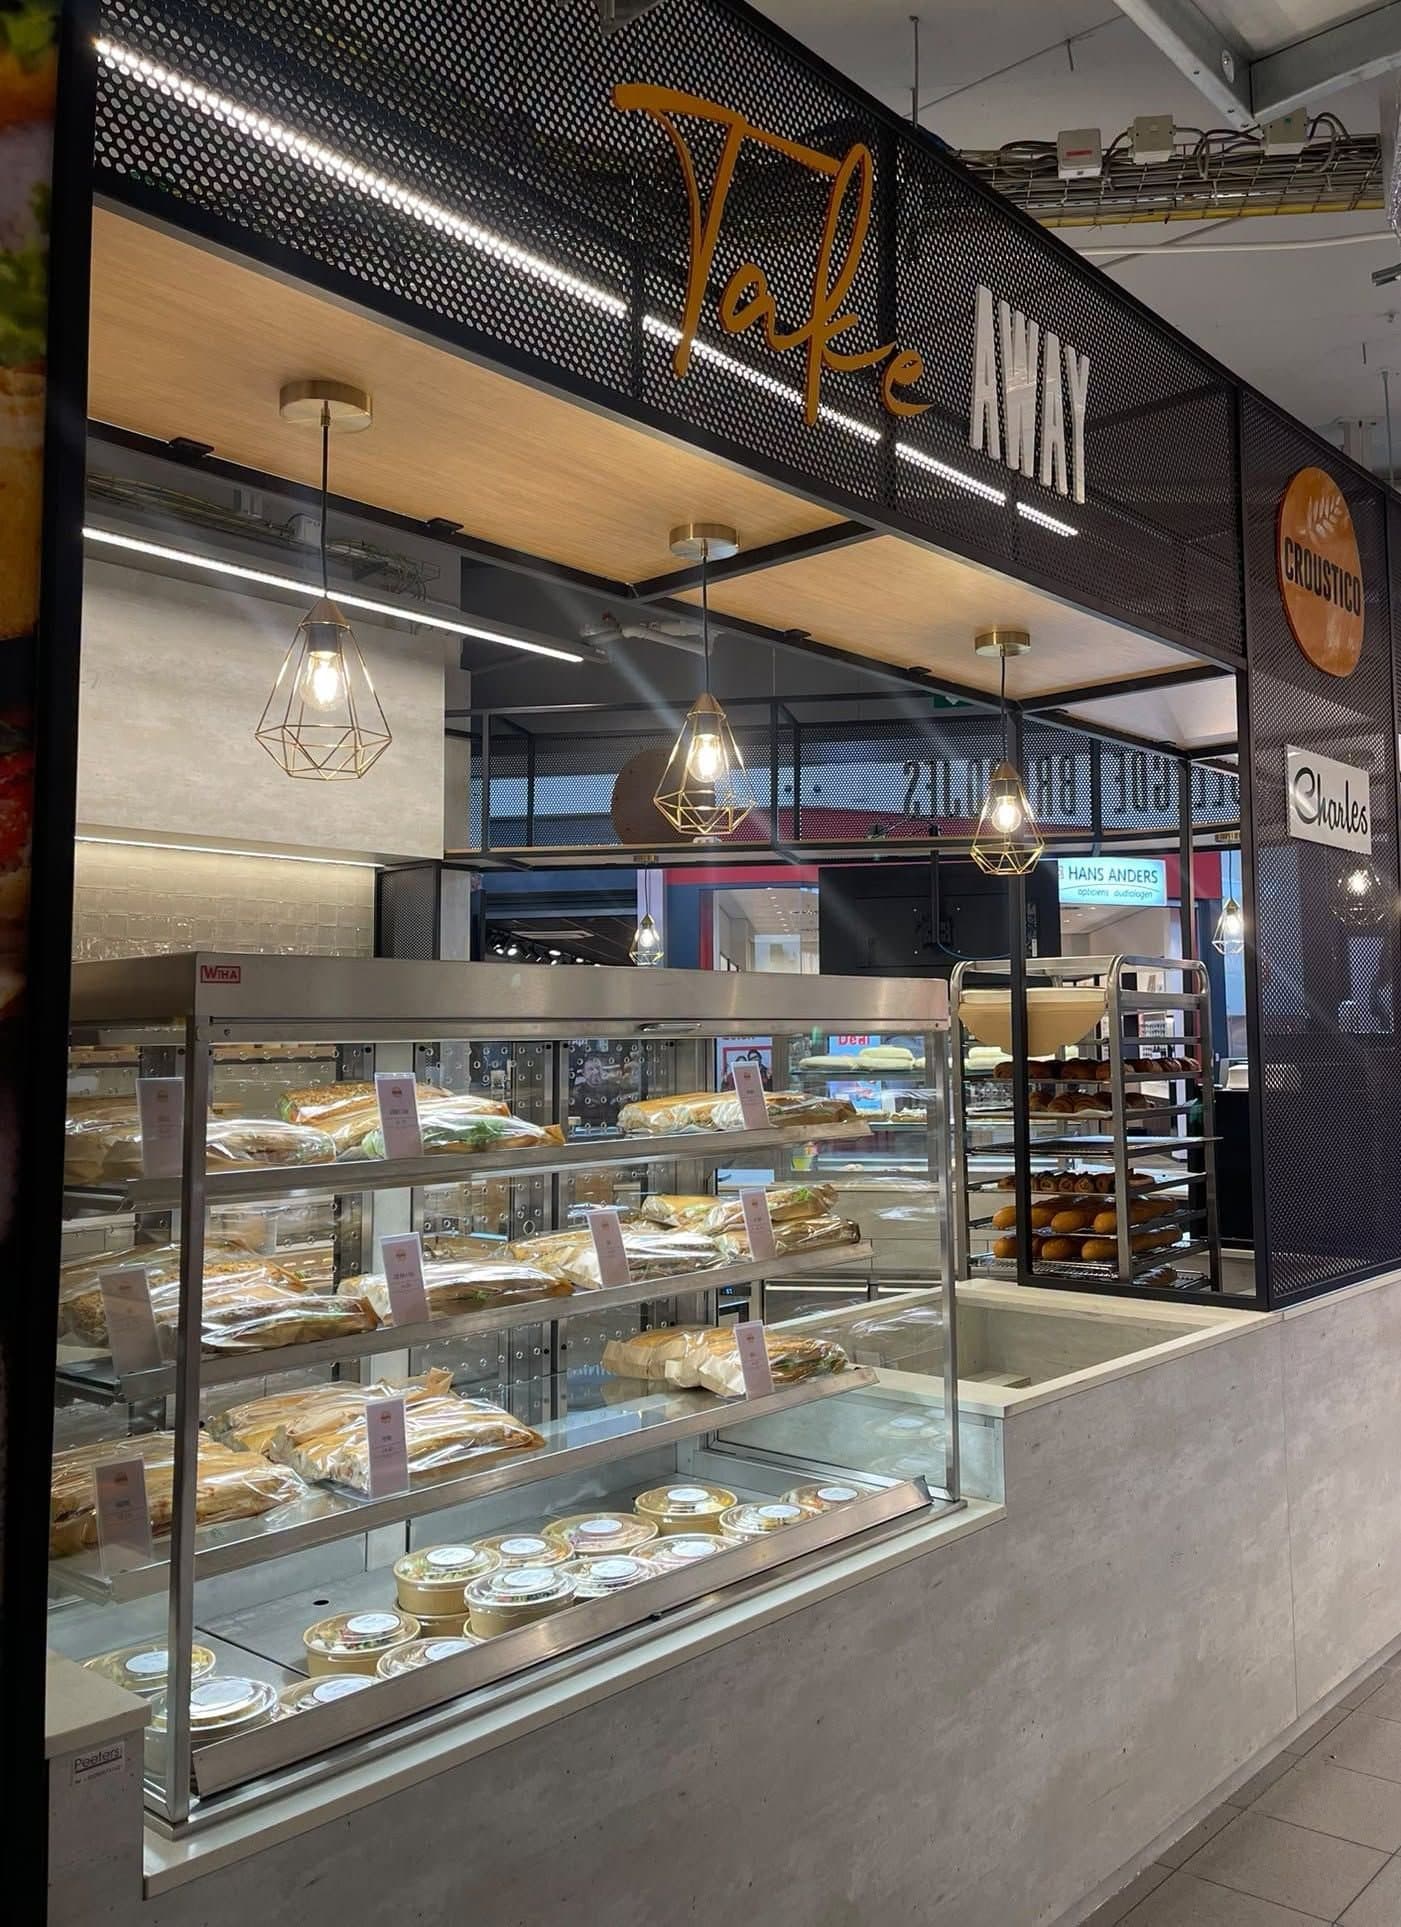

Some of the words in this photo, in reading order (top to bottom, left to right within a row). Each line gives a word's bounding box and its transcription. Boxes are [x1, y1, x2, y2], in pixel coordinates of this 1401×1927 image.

[613, 83, 934, 427] Take
[970, 283, 1091, 504] AWAY
[1283, 536, 1361, 617] CROUSTICO
[1293, 767, 1368, 836] Charles
[1068, 865, 1104, 881] HANS
[1108, 868, 1159, 884] ANDERS
